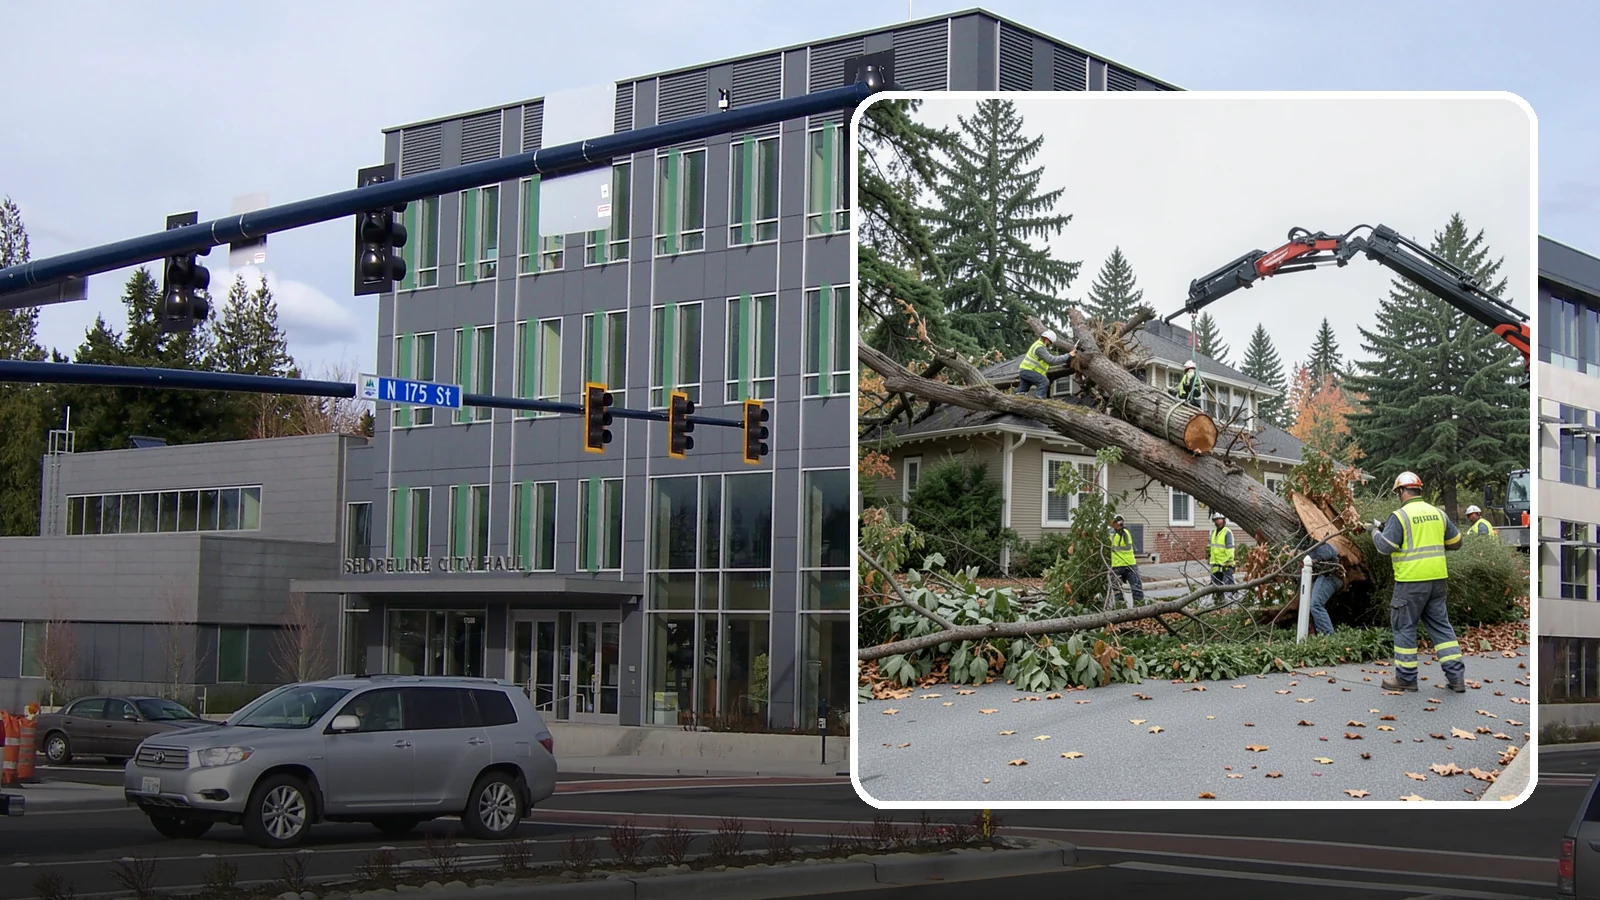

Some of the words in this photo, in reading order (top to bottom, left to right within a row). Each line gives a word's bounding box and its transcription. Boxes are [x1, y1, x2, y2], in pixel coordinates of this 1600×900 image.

[387, 380, 396, 399] N
[405, 382, 427, 403] 175
[436, 386, 451, 406] St
[344, 557, 432, 574] SHORELINE
[438, 556, 475, 572] CITY
[483, 555, 525, 572] HALL
